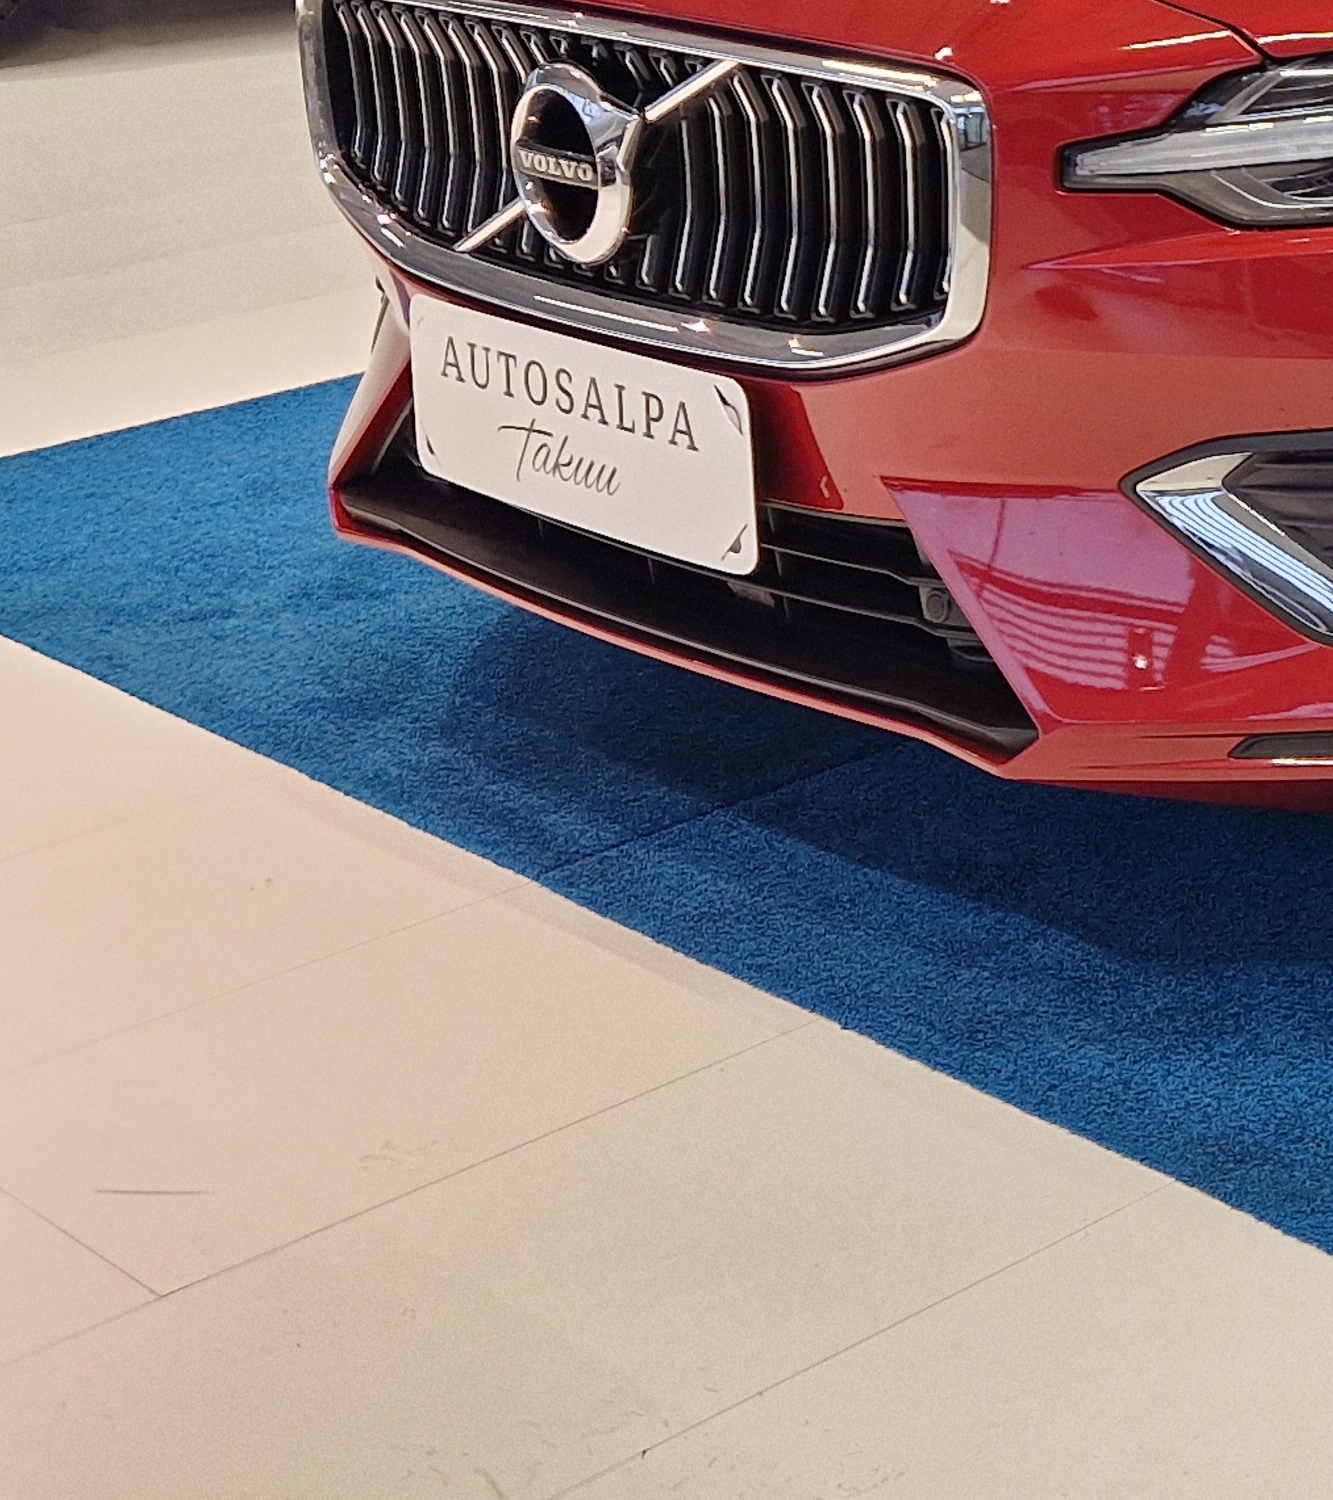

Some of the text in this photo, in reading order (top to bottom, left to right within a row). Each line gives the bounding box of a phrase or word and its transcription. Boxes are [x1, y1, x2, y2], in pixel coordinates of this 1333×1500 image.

[518, 149, 594, 182] VOLVO
[440, 335, 700, 451] AUTOSALPA
[497, 417, 622, 496] Takuu
